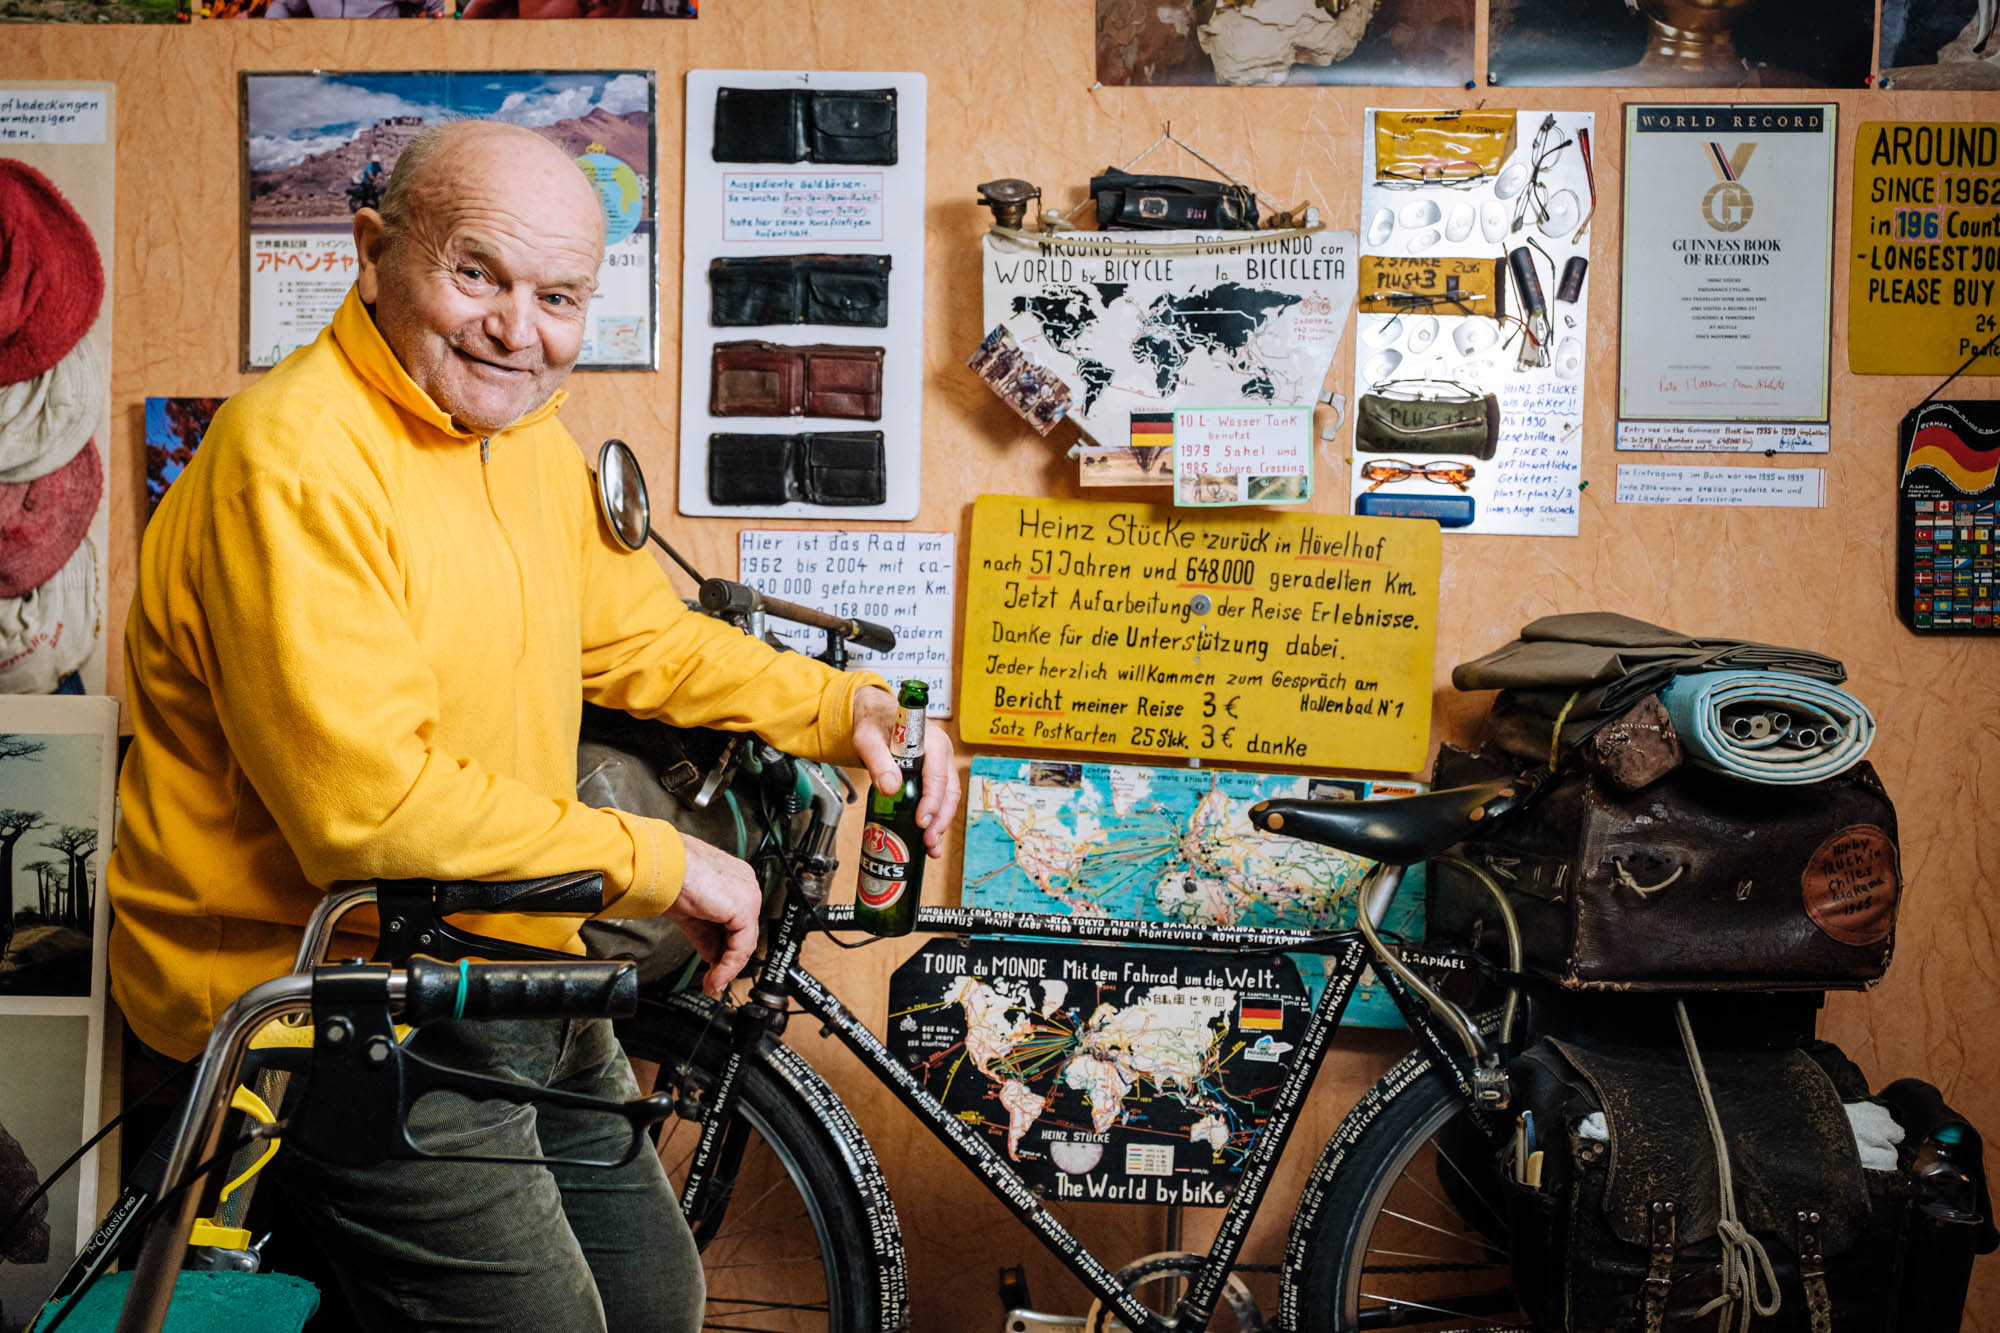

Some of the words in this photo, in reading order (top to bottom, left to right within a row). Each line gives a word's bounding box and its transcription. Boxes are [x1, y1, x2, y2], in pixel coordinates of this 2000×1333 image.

[1642, 116, 1716, 127] WORLD
[1733, 116, 1819, 127] RECORD
[1871, 127, 1997, 167] AROUND
[1871, 177, 1934, 203] SINCE
[1871, 216, 1890, 235] in
[1898, 211, 1939, 238] 196
[1672, 239, 1740, 252] GUINNESS
[1743, 239, 1781, 252] BOOK
[994, 259, 1072, 285] WORLD
[1105, 259, 1173, 282] BICYCLE
[1246, 259, 1345, 281] BICICLETA
[1684, 254, 1701, 266] OF
[1705, 254, 1770, 266] RECORDS
[1869, 279, 1941, 305] PLEASE
[1954, 279, 1995, 307] BUY
[1976, 314, 1997, 332] 24
[1224, 445, 1265, 457] Sahel
[742, 534, 782, 551] Hier
[797, 535, 818, 550] ist
[829, 535, 859, 551] das
[868, 535, 906, 551] Rad
[918, 542, 941, 551] von
[1019, 509, 1095, 541] Heinz
[1275, 539, 1291, 553] in
[1299, 527, 1387, 561] Hövelhof
[742, 557, 782, 573] 1962
[797, 558, 816, 573] bis
[826, 557, 868, 573] 2004
[879, 558, 902, 573] mit
[983, 554, 1021, 573] nach
[1030, 550, 1052, 574] 51
[1058, 551, 1131, 578] Jahren
[1143, 558, 1176, 581] und
[1269, 568, 1371, 592] geradelten
[1385, 571, 1416, 596] Km.
[822, 581, 915, 599] gefahrenen
[894, 603, 918, 616] mit
[1004, 582, 1057, 609] Jetzt
[1069, 588, 1192, 623] Aufarbeitung
[1217, 596, 1245, 617] der
[1252, 597, 1303, 621] Reise
[1311, 601, 1419, 631] Erlebnisse.
[1060, 624, 1083, 646] für
[1092, 625, 1119, 647] die
[1126, 626, 1269, 662] Unterstützung
[1286, 634, 1345, 660] dabei.
[986, 654, 1034, 675] Jeder
[1039, 656, 1108, 681] herzlich
[1226, 672, 1262, 686] zum
[1271, 670, 1347, 692] Gespräch
[1355, 680, 1378, 692] am
[995, 686, 1062, 711] Bericht
[1071, 698, 1129, 715] meiner
[1137, 696, 1185, 717] Reise
[1203, 692, 1217, 718] 3
[1223, 696, 1241, 720] €
[1300, 694, 1372, 716] Hallenbad
[990, 717, 1025, 737] Satz
[1130, 727, 1156, 747] 25
[1201, 724, 1215, 749] 3
[1221, 727, 1235, 749] €
[861, 858, 904, 878] ECK'S
[1139, 928, 1203, 941] MONTEVIDEO
[1212, 932, 1241, 943] ROME
[923, 953, 966, 975] TOUR
[973, 961, 989, 976] du
[992, 957, 1047, 978] MONDE
[1063, 959, 1088, 980] Mit
[1091, 966, 1117, 982] dem
[1123, 962, 1178, 985] Fahrrad
[1184, 975, 1201, 986] um
[1204, 969, 1224, 987] die
[1225, 967, 1281, 989] Welt.
[1413, 953, 1466, 970] RAPHAEL
[1041, 1130, 1067, 1140] HEINZ
[1055, 1173, 1083, 1197] The
[1086, 1174, 1147, 1200] World
[1156, 1179, 1178, 1204] by
[95, 1208, 126, 1247] Classic
